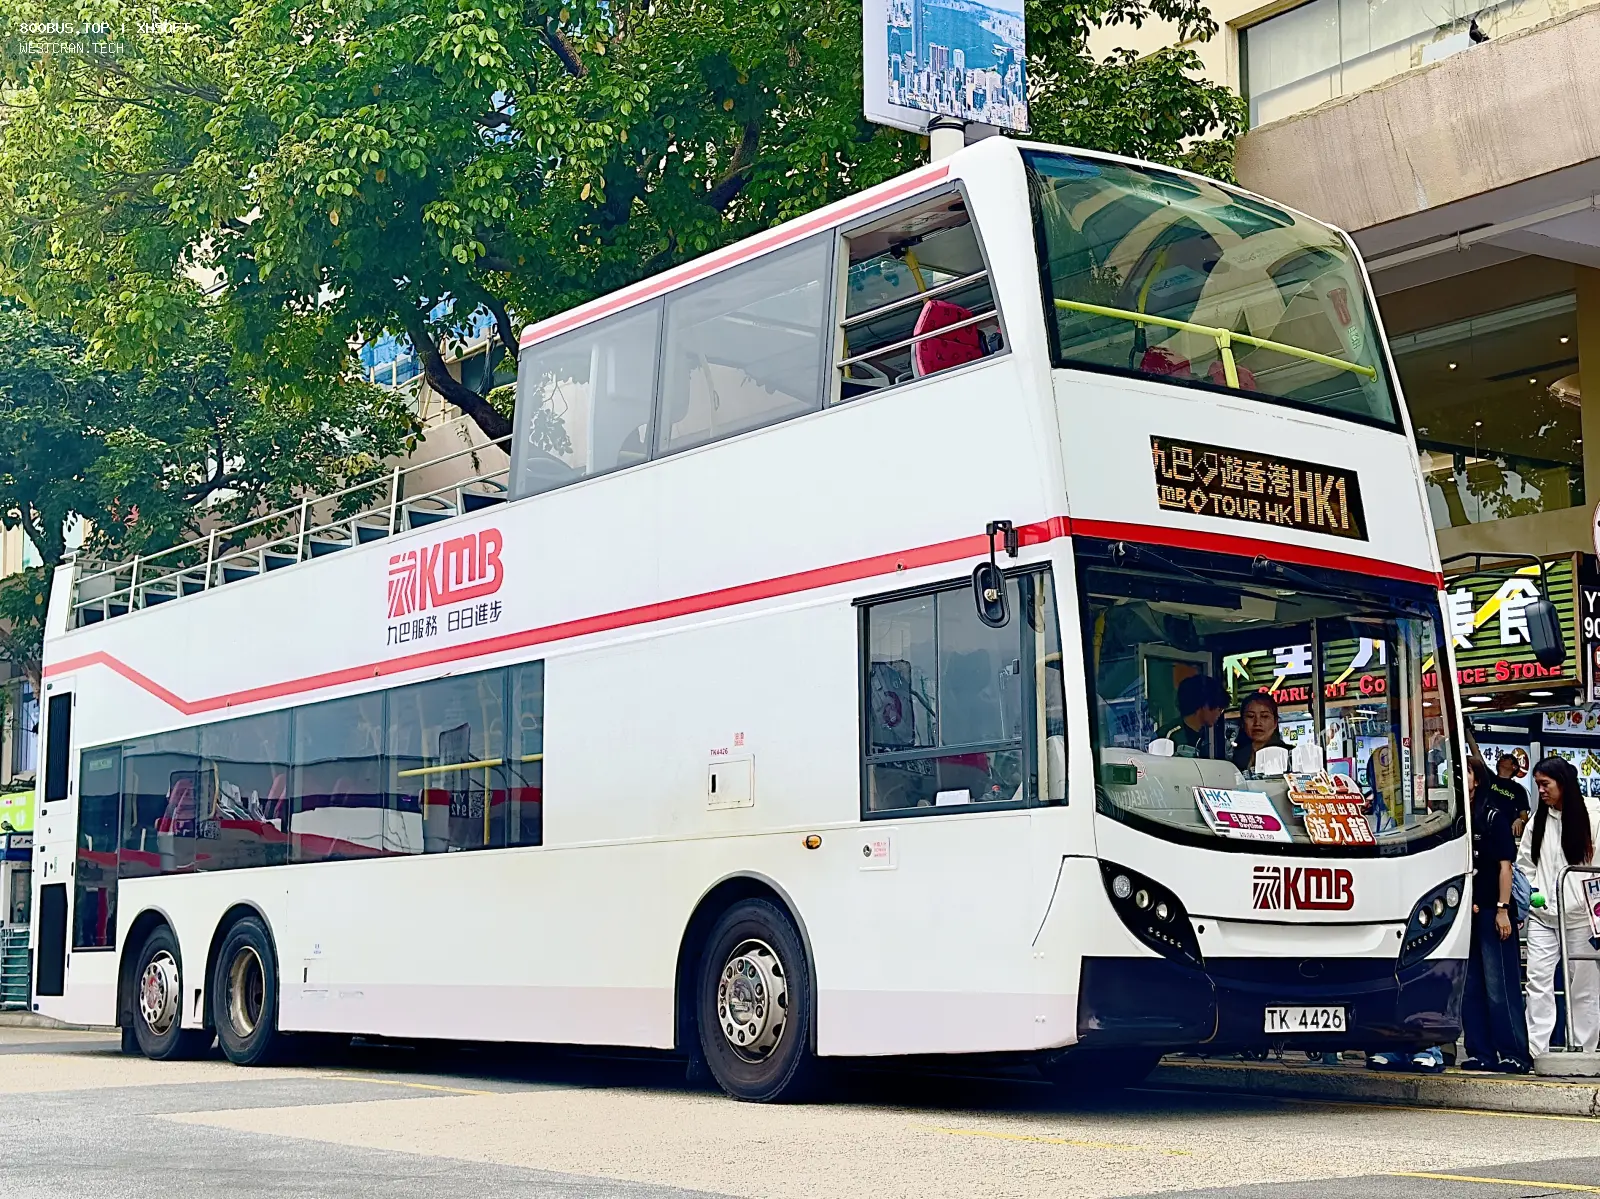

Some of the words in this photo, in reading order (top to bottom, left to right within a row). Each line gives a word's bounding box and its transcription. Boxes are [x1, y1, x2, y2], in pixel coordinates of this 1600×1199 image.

[1208, 492, 1261, 520] TOUR
[1265, 502, 1294, 526] HK
[1292, 468, 1349, 530] HK1
[419, 528, 504, 611] KMB
[387, 615, 438, 646] 九巴服務
[448, 600, 502, 632] 日日進步
[1203, 789, 1232, 803] HK1
[1307, 817, 1373, 842] 遊九龍
[1283, 866, 1355, 911] KMB
[1267, 1009, 1291, 1030] TK
[1298, 1009, 1342, 1030] 4426
